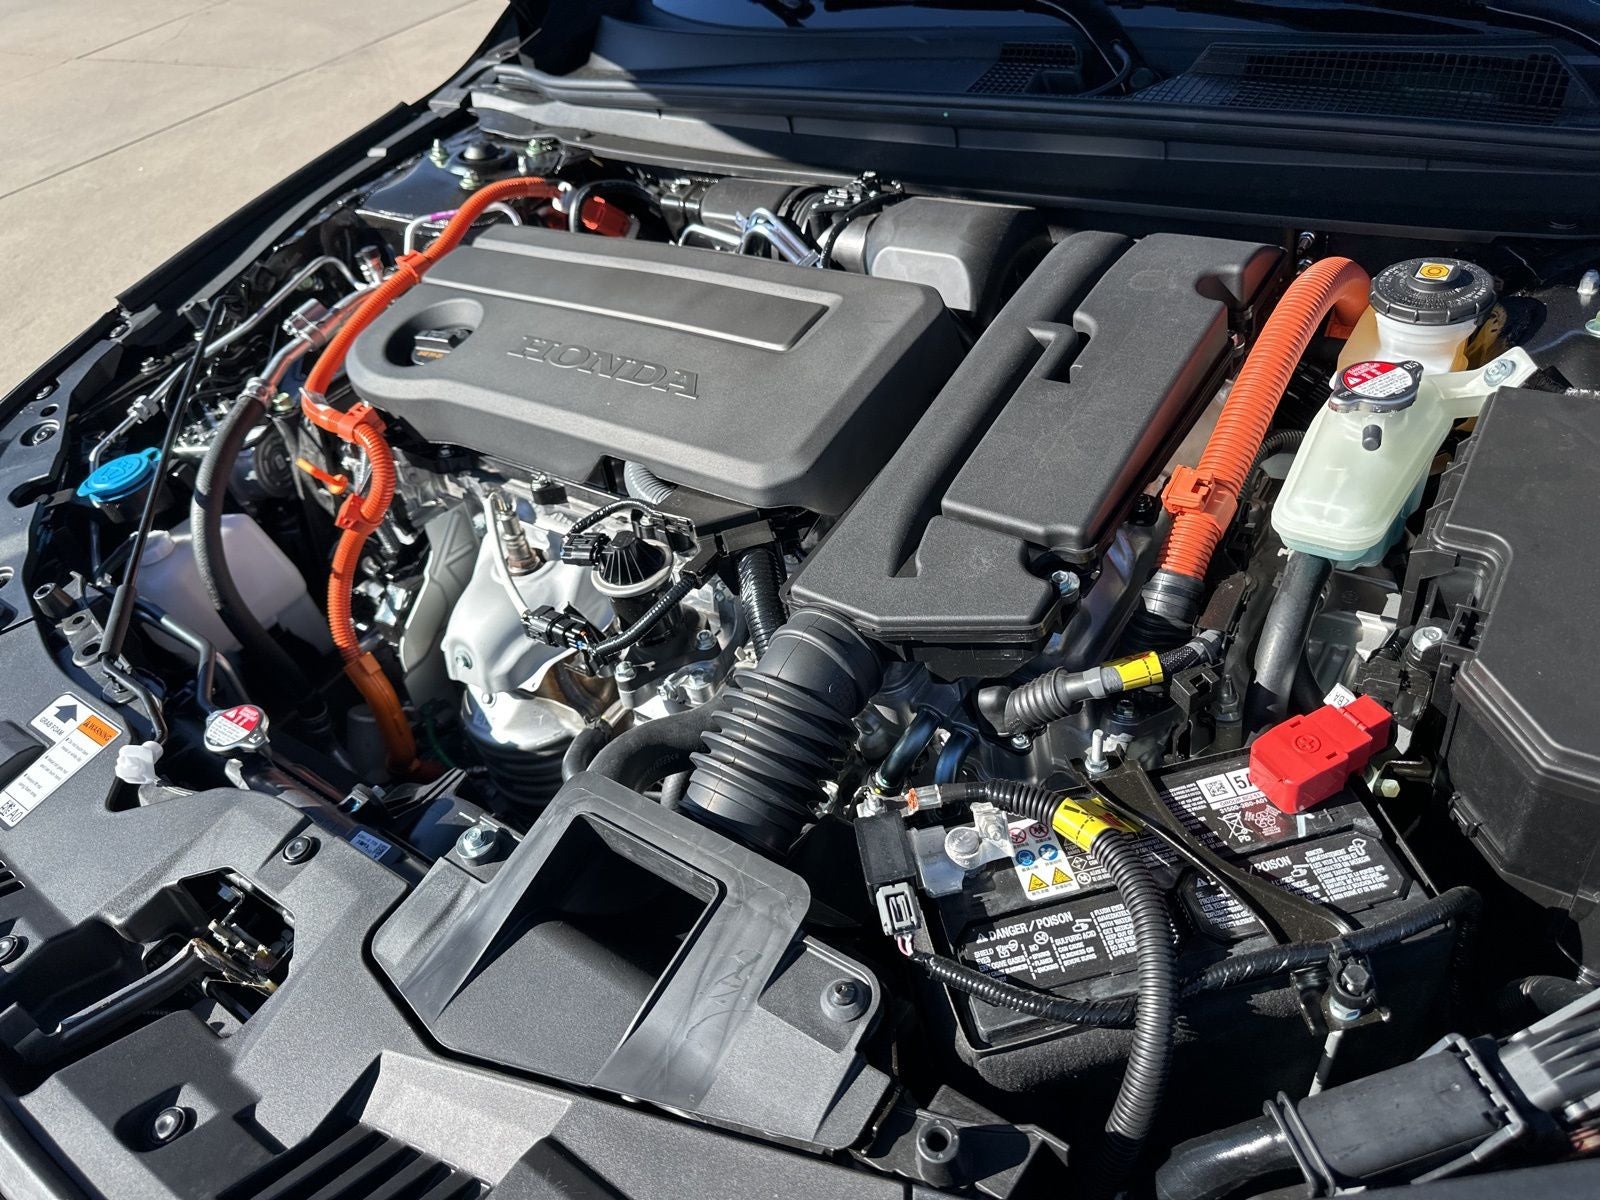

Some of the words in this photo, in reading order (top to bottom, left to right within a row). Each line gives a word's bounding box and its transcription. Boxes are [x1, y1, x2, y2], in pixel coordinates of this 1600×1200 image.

[507, 335, 699, 400] HONDA
[40, 716, 53, 729] GRAB
[51, 723, 65, 736] FOAM
[88, 722, 113, 741] WARNING
[1238, 834, 1252, 844] Pb
[1055, 933, 1083, 946] SULFURIC
[1083, 930, 1097, 940] ACID
[974, 948, 994, 959] SHIELD
[1029, 944, 1040, 953] NO
